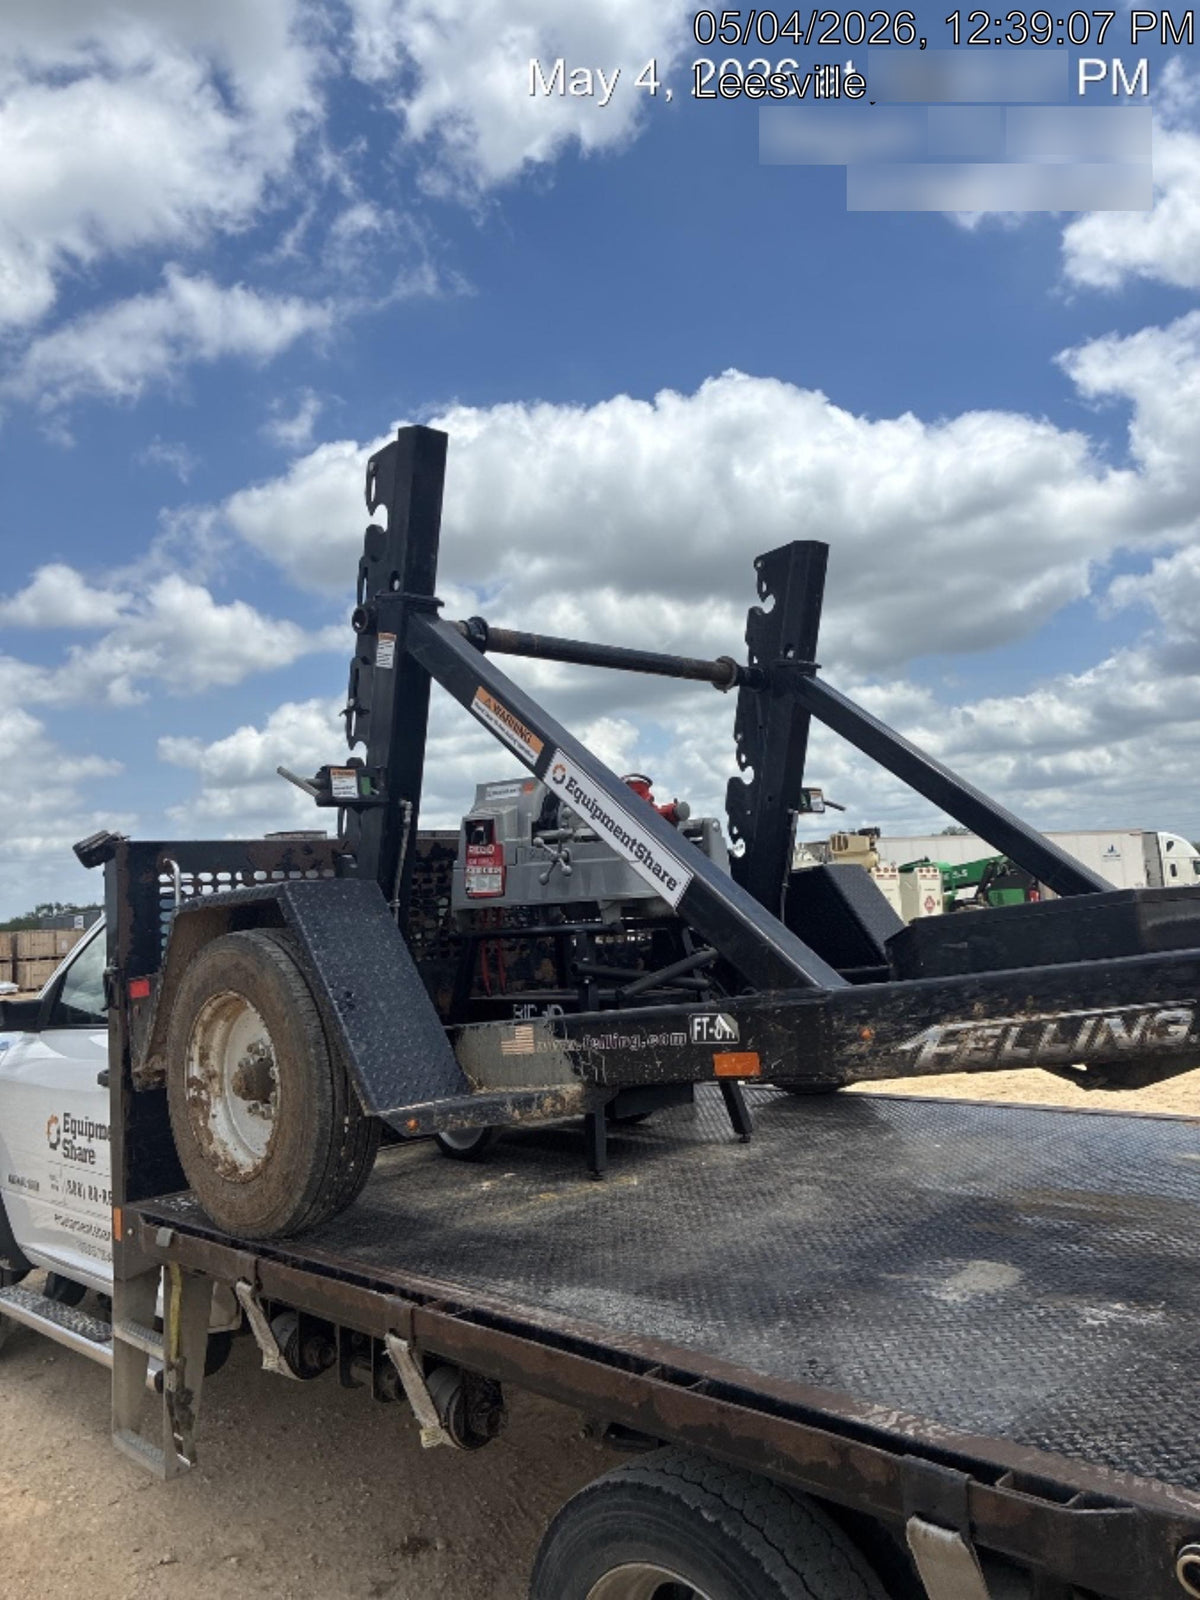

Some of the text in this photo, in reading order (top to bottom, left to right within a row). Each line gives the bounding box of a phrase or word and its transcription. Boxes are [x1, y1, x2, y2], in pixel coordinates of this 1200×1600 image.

[564, 777, 678, 892] EquipmentShare
[63, 1112, 111, 1143] Equipm
[62, 1138, 96, 1165] Share
